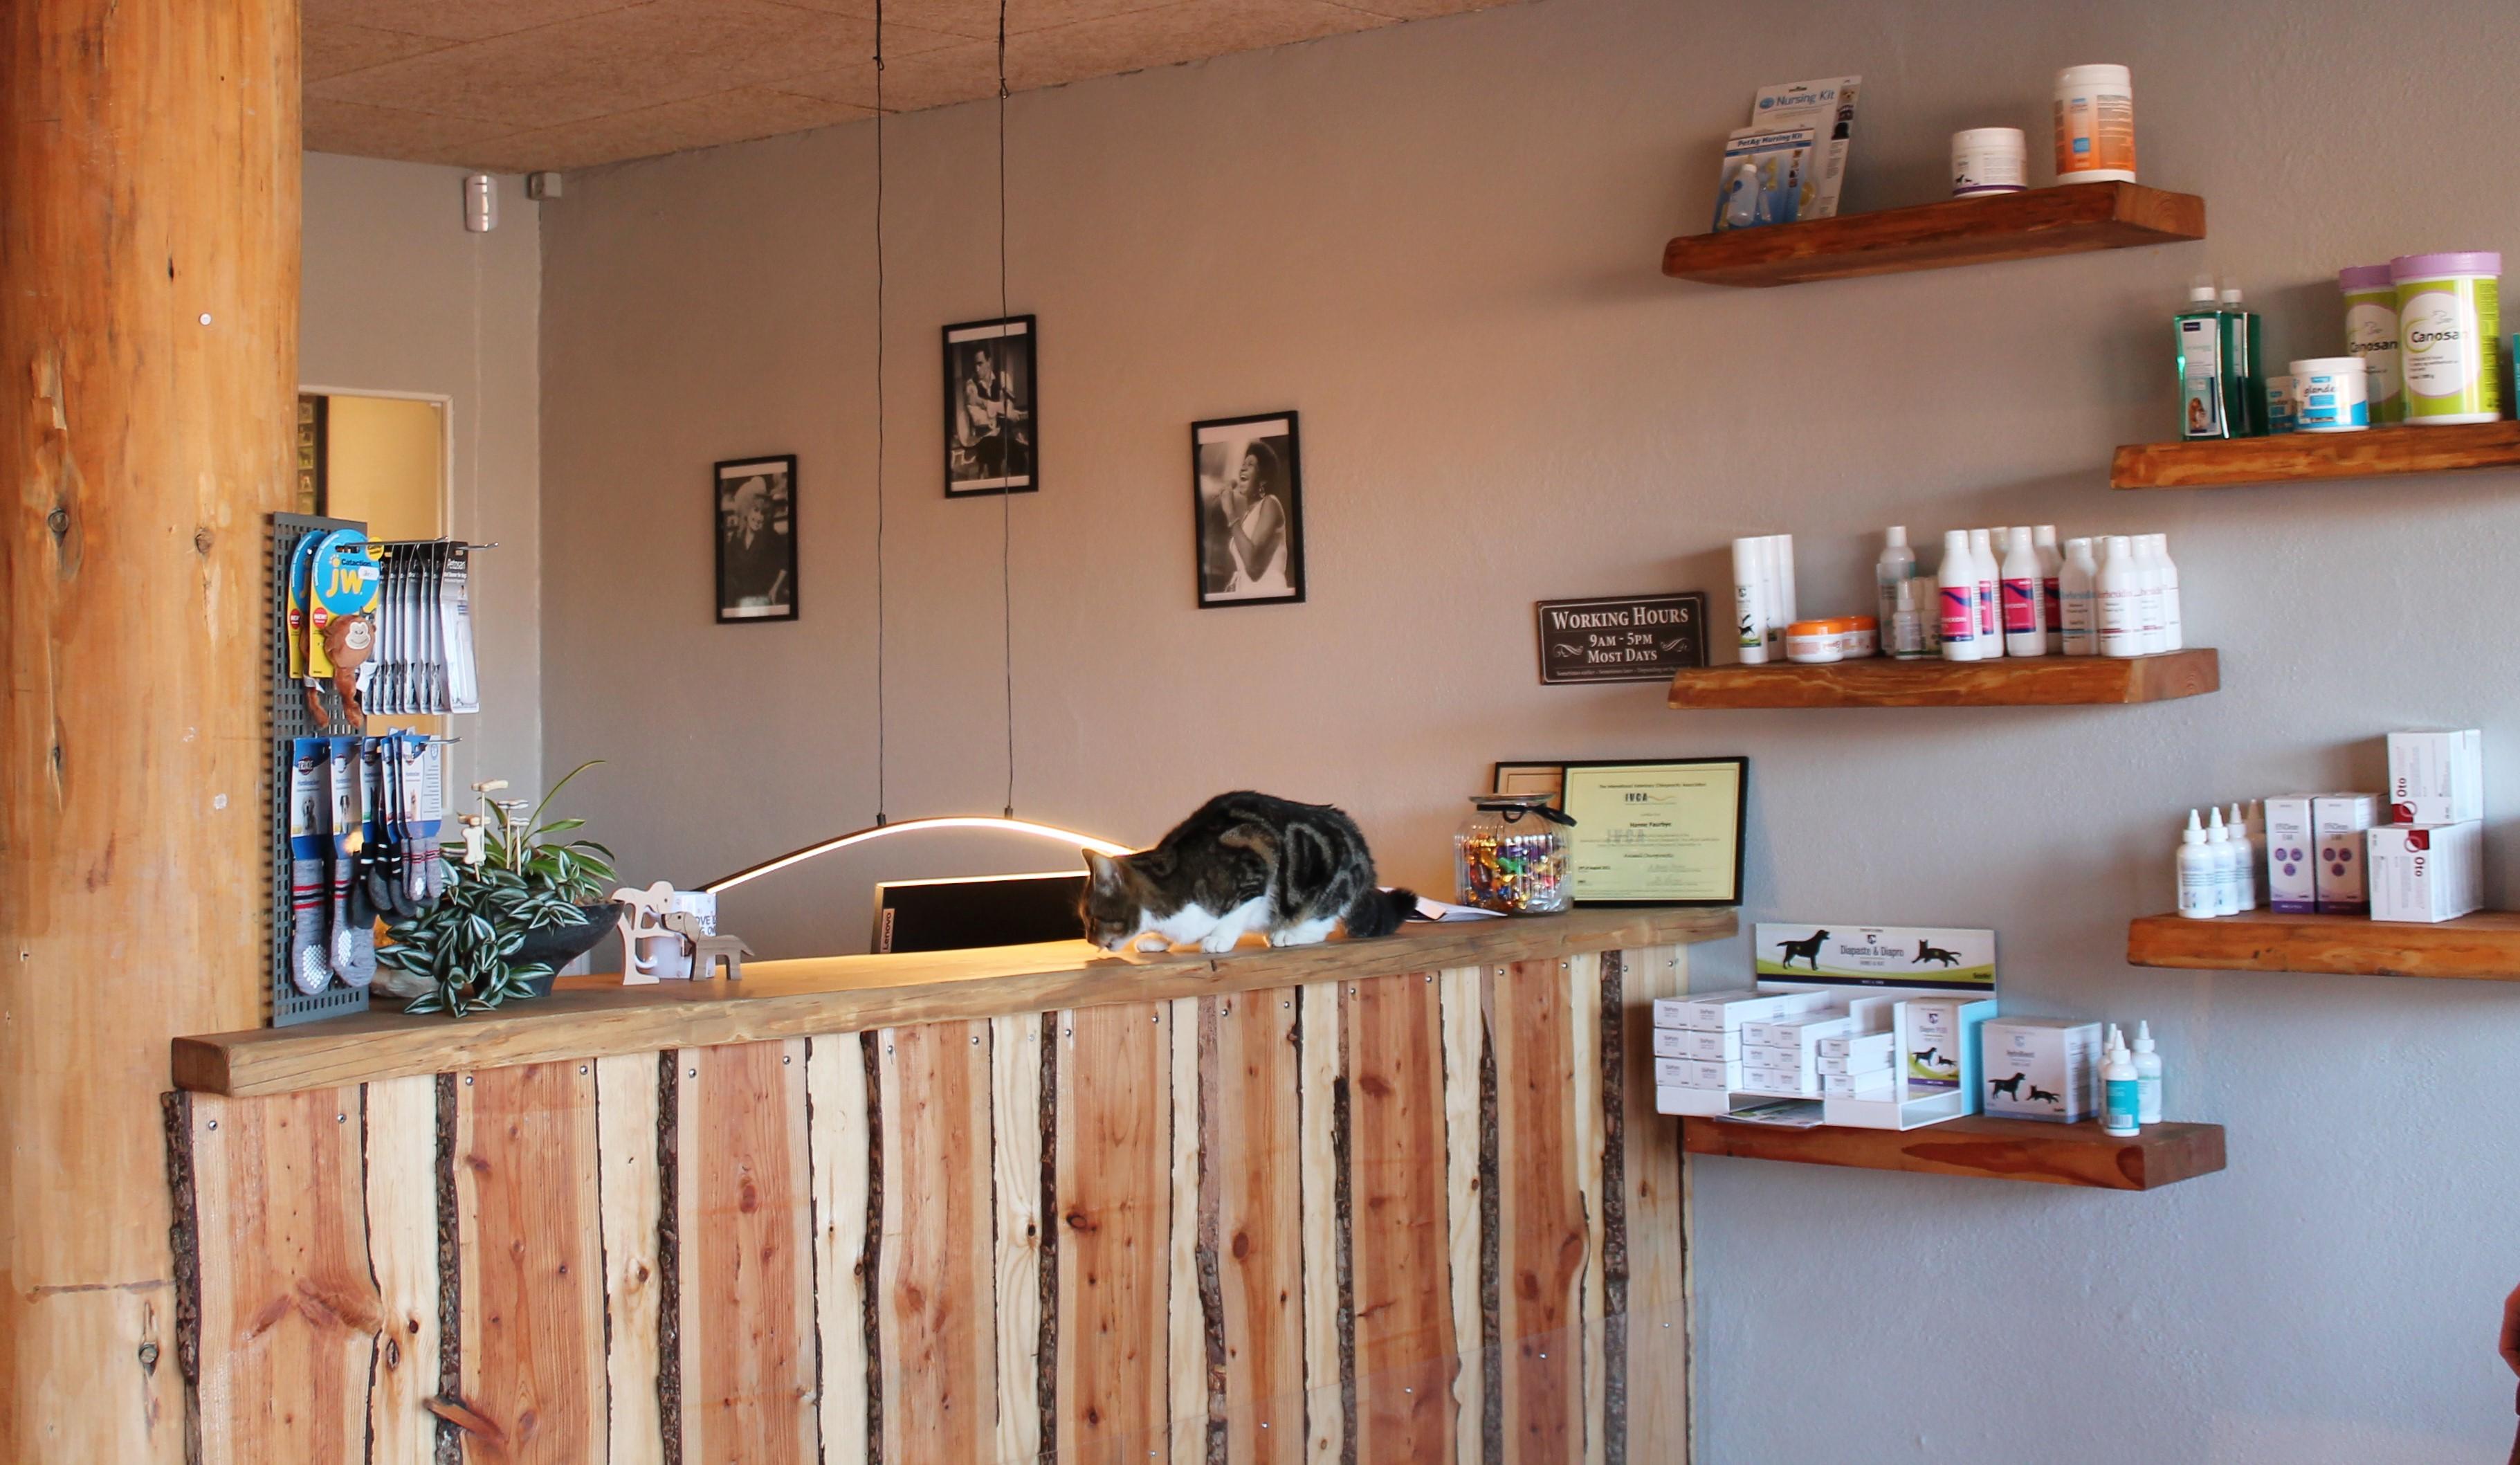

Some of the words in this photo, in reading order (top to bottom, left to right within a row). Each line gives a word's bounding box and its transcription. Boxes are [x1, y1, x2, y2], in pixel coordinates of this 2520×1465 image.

[1776, 93, 1817, 107] Nursing
[1819, 89, 1835, 101] Kit
[2350, 340, 2398, 353] Canosan
[2304, 383, 2336, 397] glande
[341, 558, 372, 567] Cataction
[1551, 610, 1629, 630] WORKING
[1633, 606, 1689, 626] HOURS
[1589, 634, 1616, 647] 9AM
[1627, 633, 1653, 645] 5PM
[1587, 650, 1623, 664] MOST
[1626, 648, 1658, 662] DAYS
[1625, 792, 1648, 802] IVCA
[882, 912, 892, 950] Lenovo
